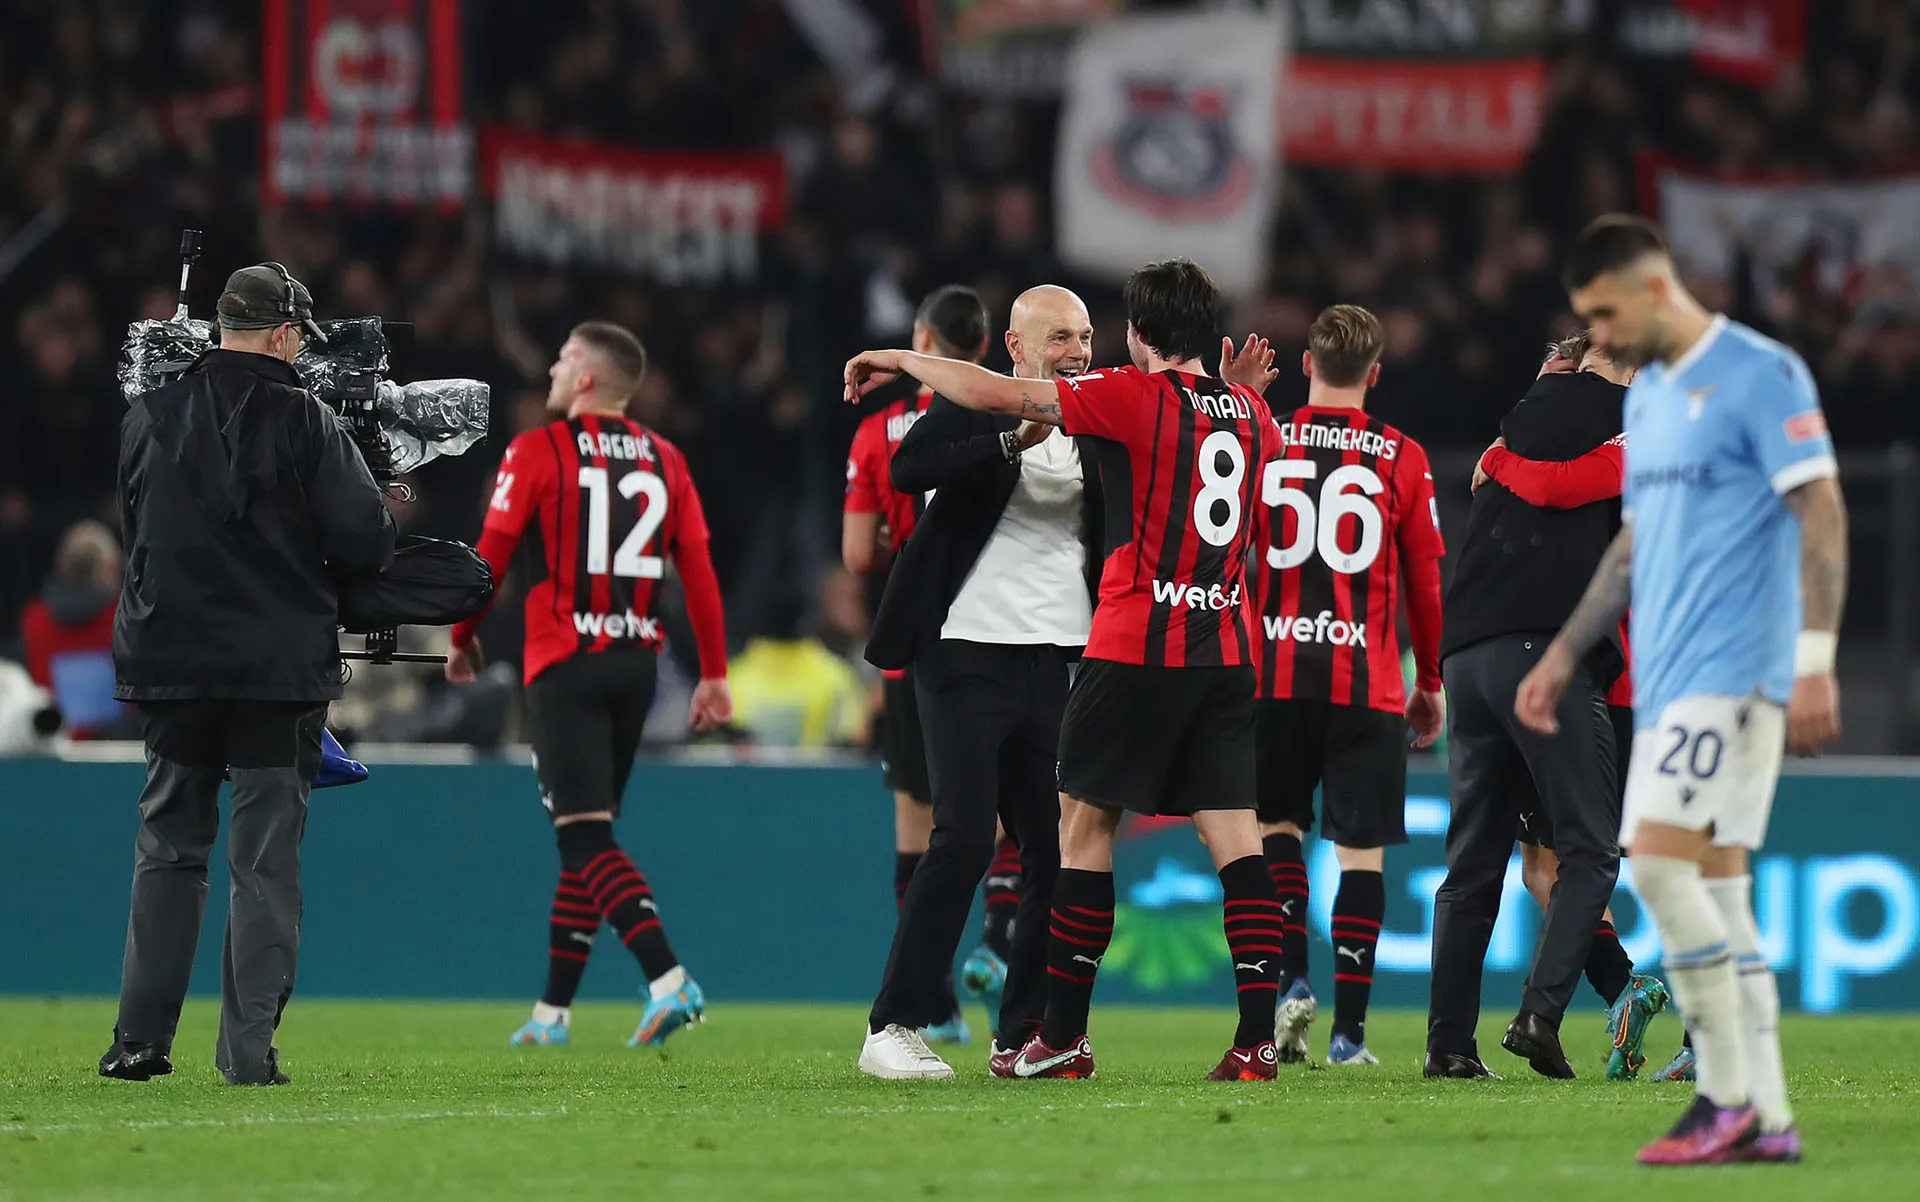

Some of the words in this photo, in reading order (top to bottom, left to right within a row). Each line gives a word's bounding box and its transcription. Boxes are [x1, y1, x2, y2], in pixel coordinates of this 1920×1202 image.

[1182, 387, 1251, 419] TONALI
[1281, 422, 1397, 460] ELEMAEKERS
[1193, 431, 1246, 547] 8
[1261, 459, 1385, 574] 56
[578, 466, 669, 579] 12
[1262, 610, 1367, 648] wefox
[1658, 724, 1723, 779] 20
